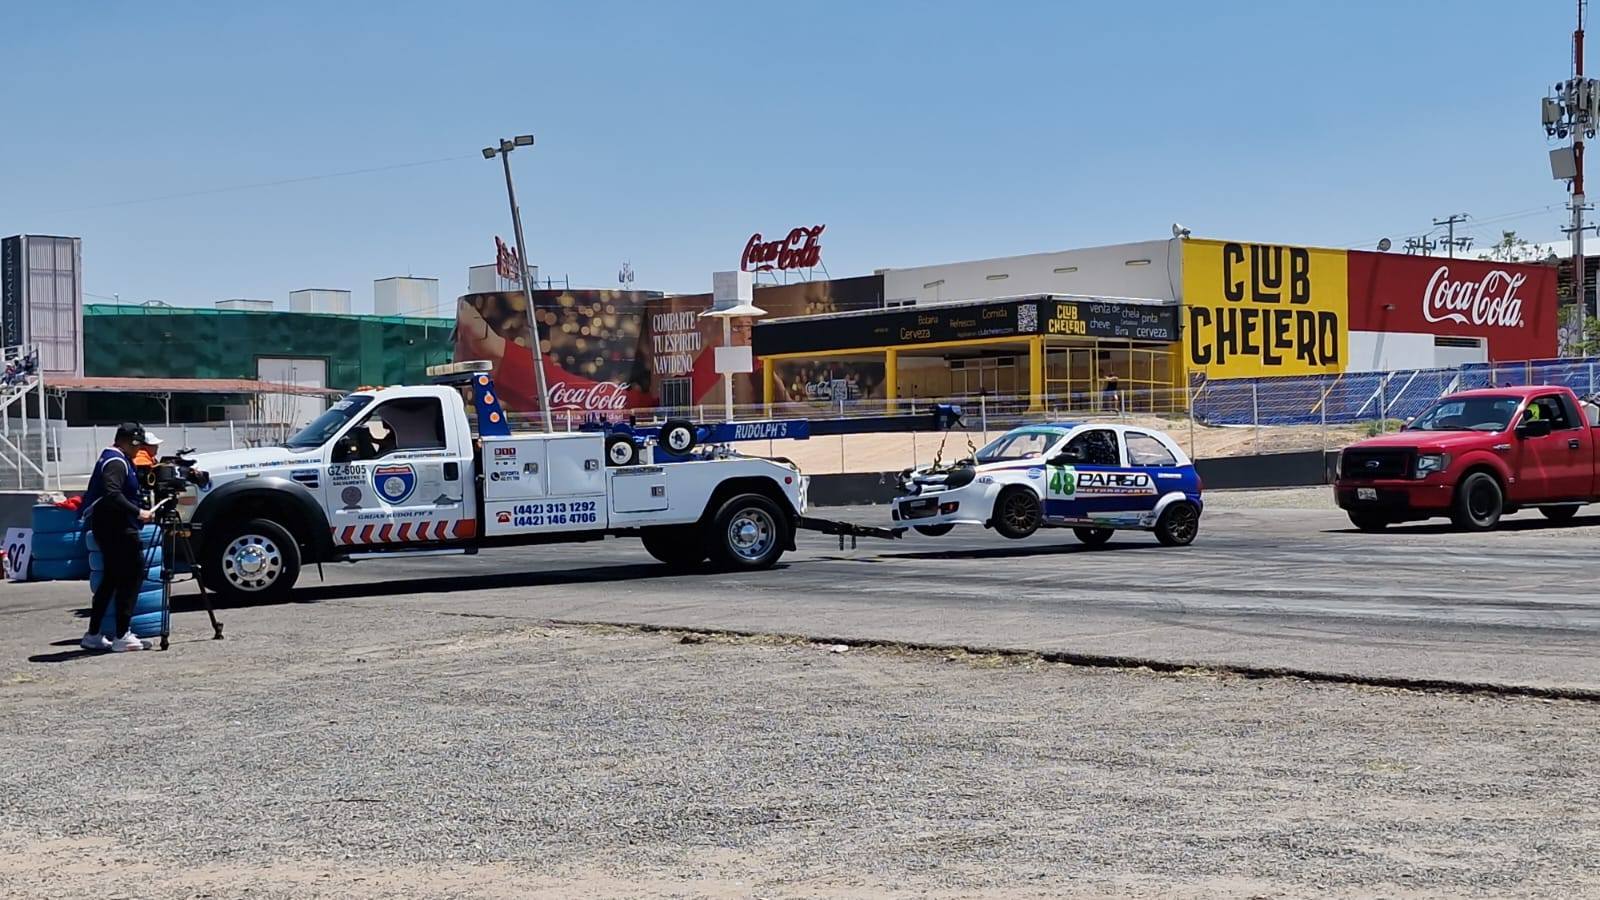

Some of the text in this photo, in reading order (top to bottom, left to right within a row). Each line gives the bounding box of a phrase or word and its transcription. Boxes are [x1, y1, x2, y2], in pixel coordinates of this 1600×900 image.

[1223, 243, 1310, 304] CLUB
[982, 308, 1008, 320] Comida
[1056, 304, 1078, 320] CLUB
[1089, 303, 1121, 314] venta de
[1122, 307, 1140, 319] chela
[653, 311, 695, 332] COMPARTE
[1141, 313, 1158, 325] pinta
[900, 327, 931, 340] Cerveza
[1048, 319, 1086, 335] CHELERO
[1136, 327, 1168, 338] cerveza
[1190, 306, 1339, 366] CHELERO
[653, 335, 664, 353] TU
[327, 464, 367, 476] GZ-6005
[1050, 472, 1075, 496] 48
[513, 501, 596, 515] (442) 313 1292
[514, 512, 596, 527] (442) 146 4706
[8, 543, 26, 573] SC
